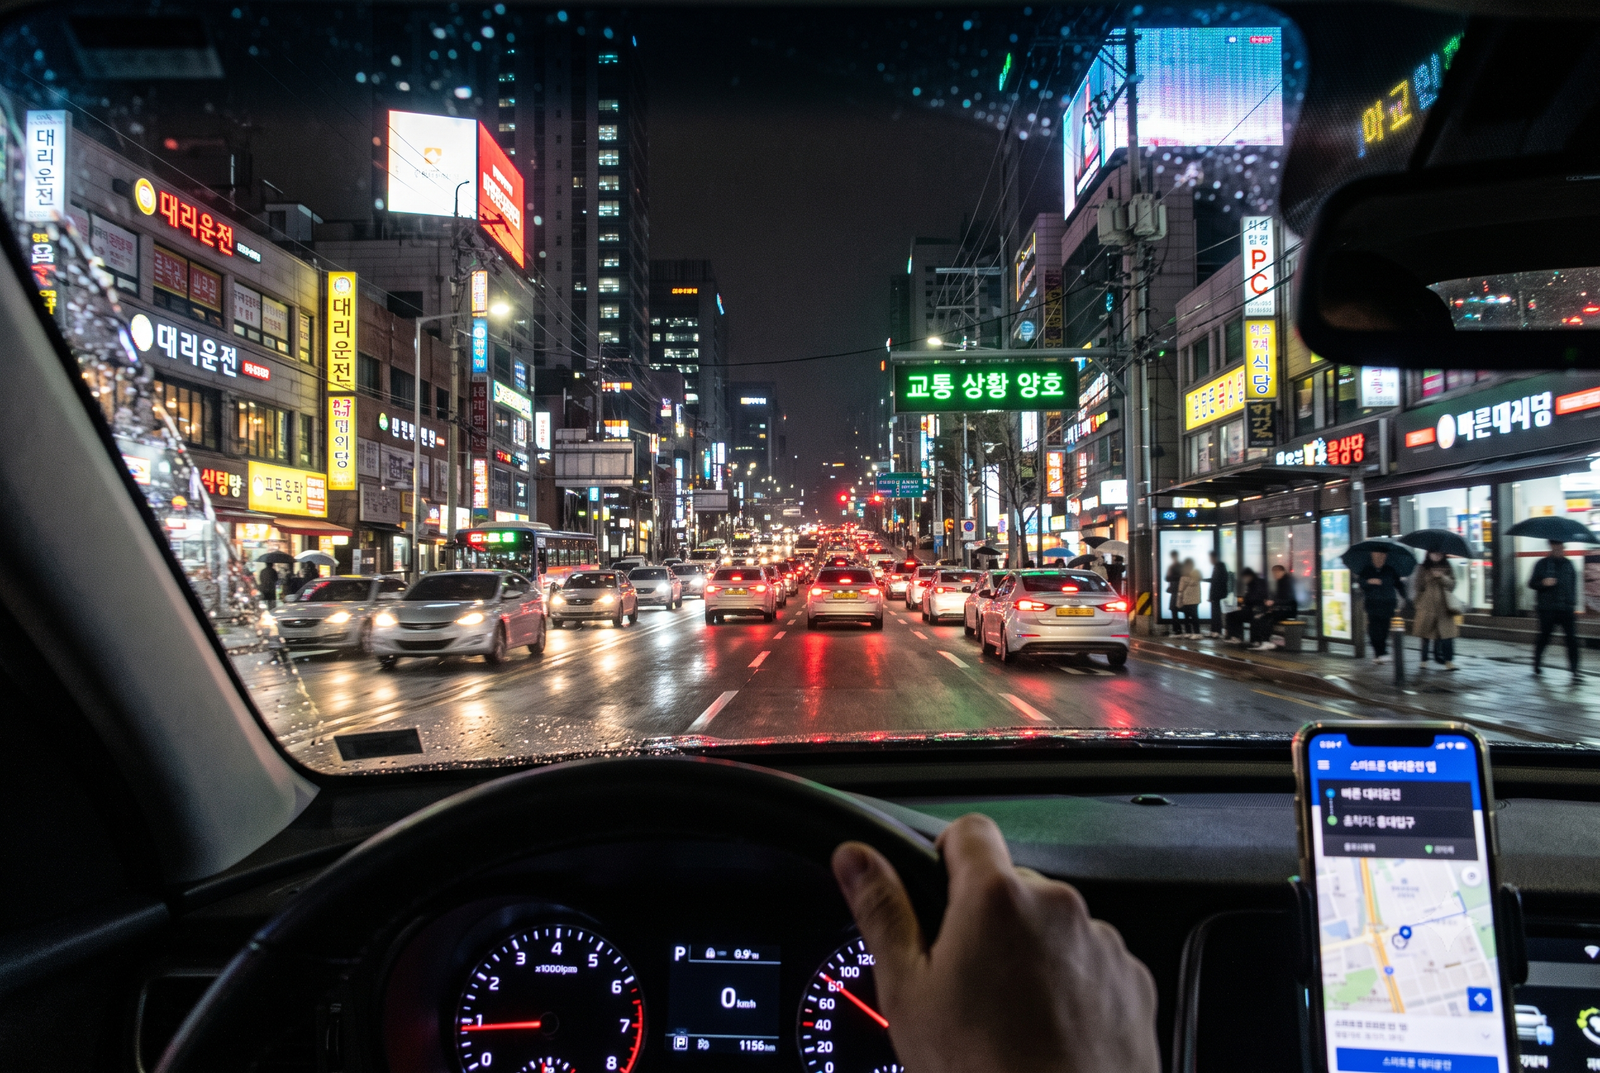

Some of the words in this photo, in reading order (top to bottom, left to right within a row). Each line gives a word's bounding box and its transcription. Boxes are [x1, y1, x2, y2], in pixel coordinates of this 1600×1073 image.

[35, 128, 55, 206] 대리운전
[160, 190, 234, 257] 대리운전
[331, 298, 352, 383] 대리운전
[157, 323, 238, 378] 대리운전
[1252, 354, 1271, 394] 식당
[907, 374, 954, 399] 교통
[962, 373, 1009, 399] 상황
[1017, 372, 1064, 399] 양호
[551, 942, 562, 956] 4
[674, 946, 686, 961] P
[515, 952, 526, 966] 3
[588, 953, 598, 968] 5
[840, 966, 860, 978] 100
[489, 976, 500, 991] 2
[611, 980, 622, 994] 6
[721, 987, 736, 1009] 0
[819, 998, 836, 1010] 60
[476, 1014, 483, 1027] 1
[619, 1018, 631, 1033] 7
[815, 1019, 832, 1031] 40
[739, 1040, 765, 1051] 1156
[817, 1041, 834, 1053] 20
[481, 1052, 492, 1067] 0
[606, 1056, 617, 1071] 8
[825, 1062, 834, 1073] 0
